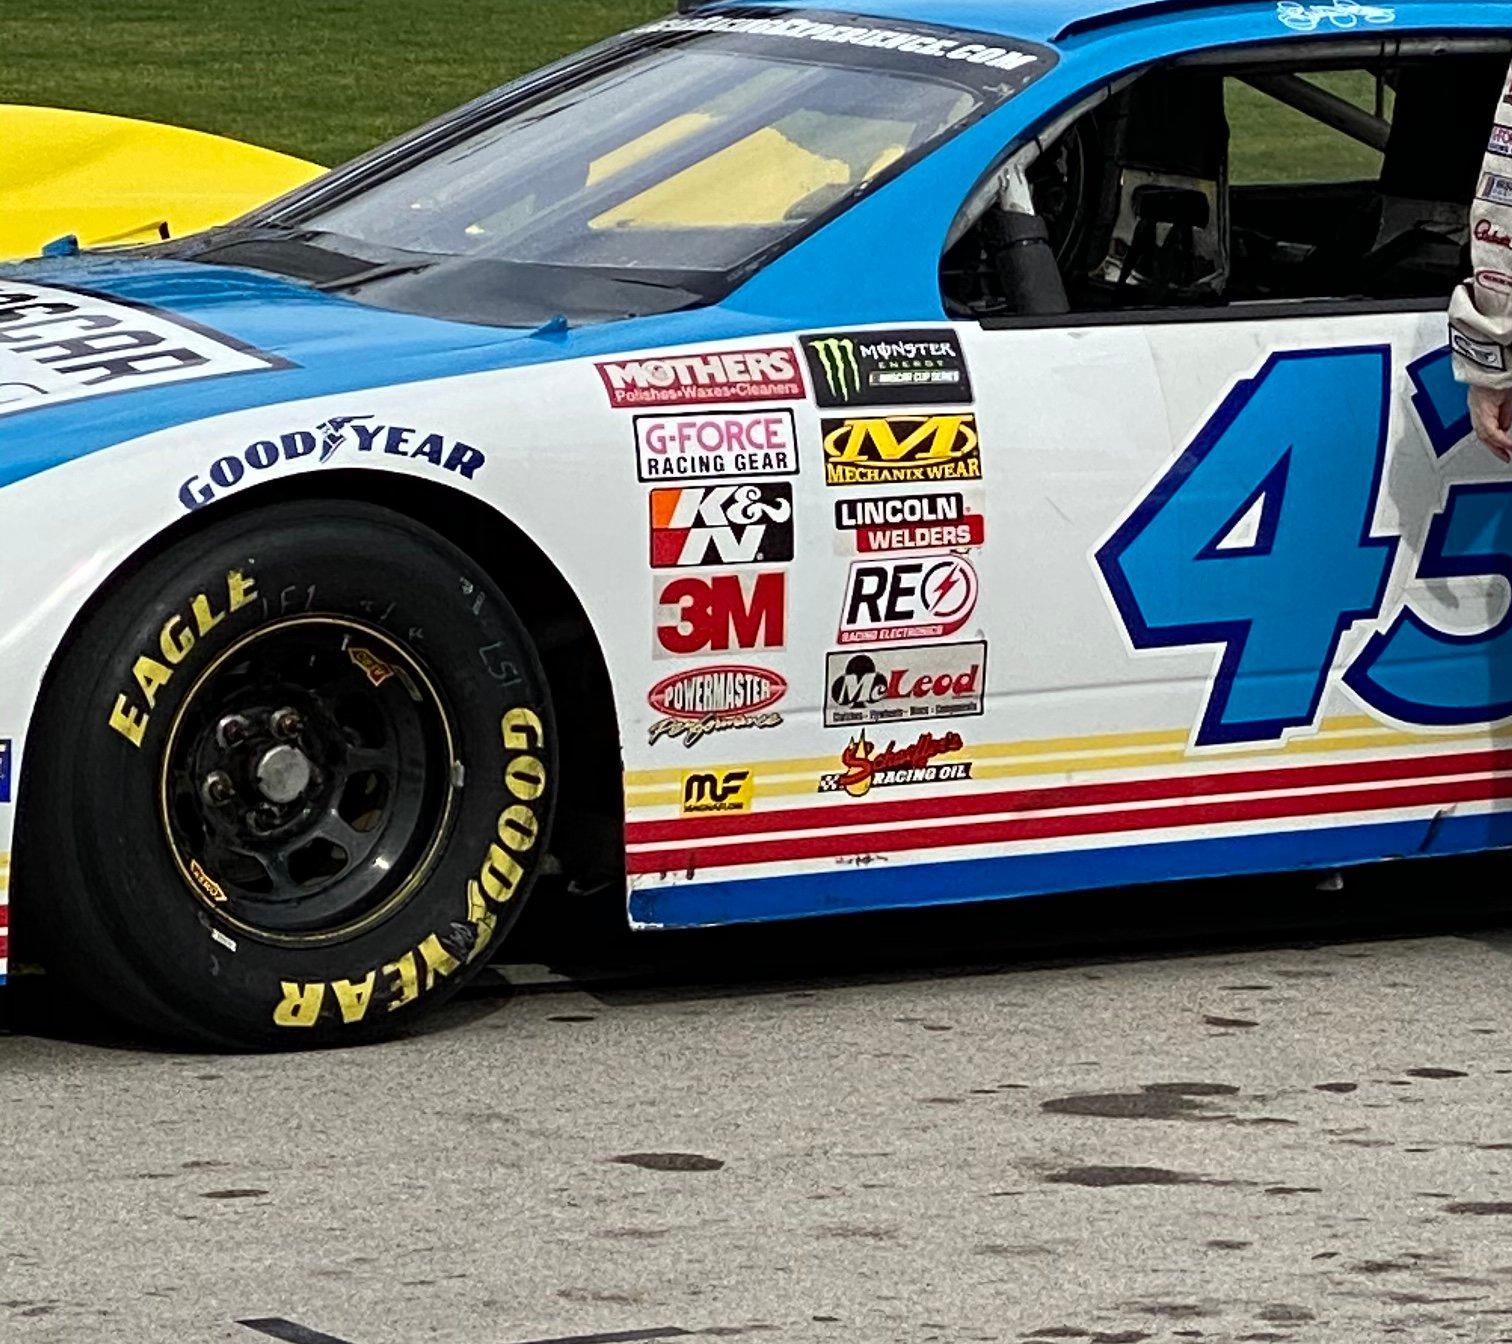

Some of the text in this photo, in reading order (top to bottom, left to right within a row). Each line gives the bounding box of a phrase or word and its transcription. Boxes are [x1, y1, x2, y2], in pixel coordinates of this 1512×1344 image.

[859, 340, 957, 360] MONSTER
[604, 350, 795, 389] MOTHERS
[646, 417, 787, 456] G-FORCE
[648, 452, 788, 476] RACING GEAR
[827, 459, 981, 484] MECHANIX WEAR
[841, 495, 958, 526] LINCOLN
[869, 524, 971, 549] WELDERS
[657, 571, 785, 655] 3M
[109, 568, 259, 748] EAGLE
[664, 671, 771, 712] POWERMASTER
[839, 664, 980, 704] McLeod
[873, 765, 967, 785] RACING OIL
